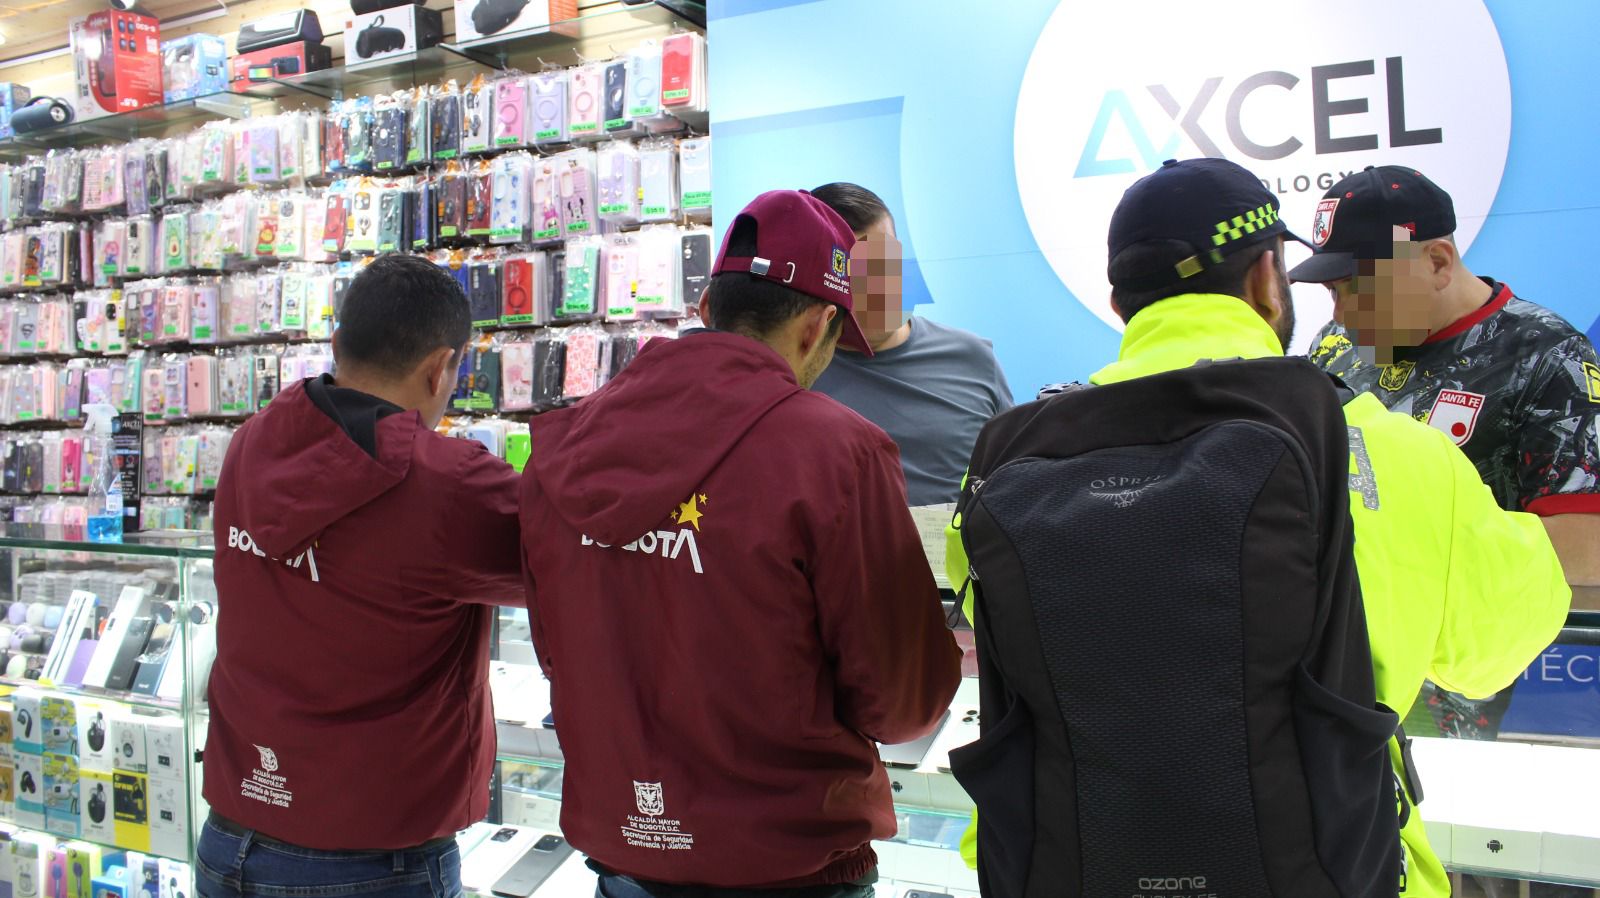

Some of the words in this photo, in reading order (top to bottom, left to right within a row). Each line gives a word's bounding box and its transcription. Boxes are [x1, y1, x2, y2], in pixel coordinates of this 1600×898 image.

[1073, 56, 1443, 178] AXCEL
[1261, 170, 1353, 194] LOG
[1440, 392, 1467, 404] SANTA
[1468, 398, 1480, 408] FE
[1090, 474, 1166, 489] OSPR
[1524, 647, 1600, 683] ÉC
[627, 814, 657, 823] ALCALDÍA
[621, 830, 651, 841] Secretaría
[627, 838, 660, 848] Convivencia
[1138, 876, 1206, 890] ozone
